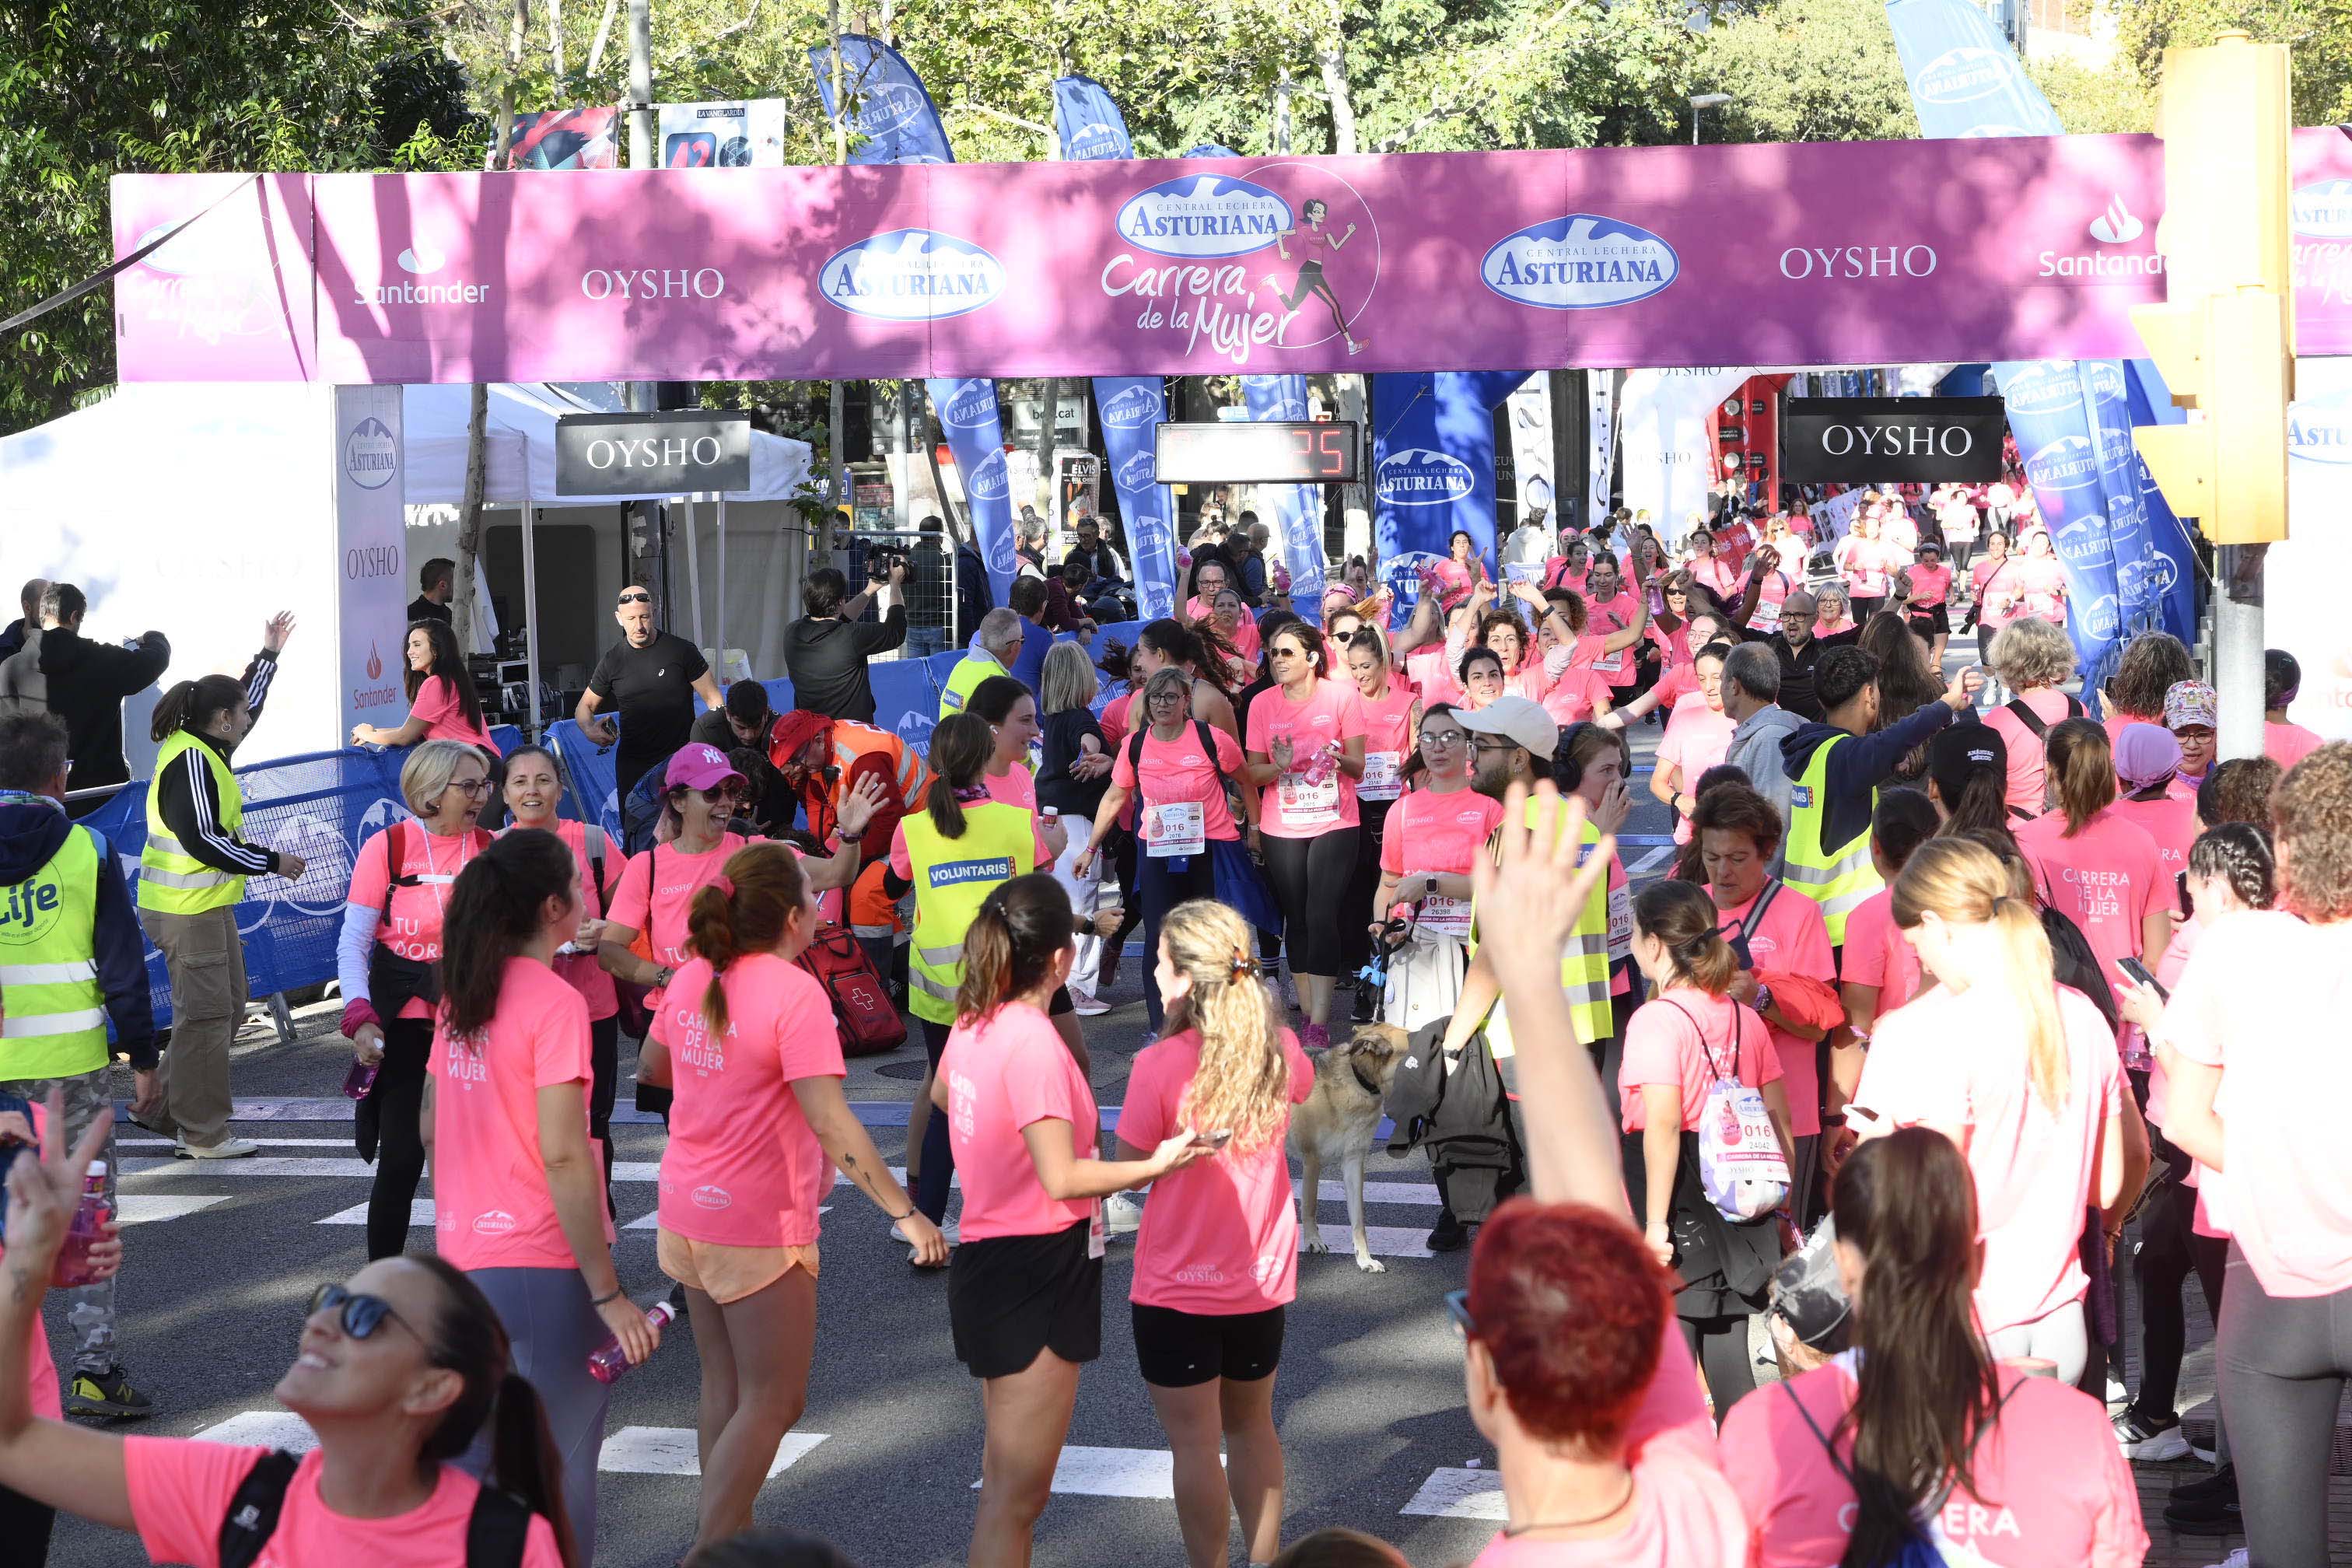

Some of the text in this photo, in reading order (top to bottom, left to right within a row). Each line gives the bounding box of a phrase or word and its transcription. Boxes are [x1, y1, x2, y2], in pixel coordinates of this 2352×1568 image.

[707, 109, 744, 117] VANGUARDIA
[1157, 201, 1274, 212] CENTRAL LECHERA
[2293, 205, 2352, 223] STUR
[1129, 205, 1279, 237] ASTURIANA
[1527, 246, 1657, 257] CENTRAL LECHERA
[1496, 251, 1663, 286] ASTURIANA
[1780, 245, 1937, 279] OYSHO
[2038, 250, 2168, 277] Santand
[581, 268, 724, 299] OYSHO
[1101, 254, 1248, 297] Carrera
[354, 280, 490, 304] Santander
[1137, 292, 1300, 364] de la Mujer
[1032, 408, 1075, 420] b.cat
[1822, 424, 1972, 457] OYSHO
[348, 443, 394, 471] ASTURIANA
[586, 436, 721, 469] OYSHO
[1072, 464, 1096, 474] ELVIS
[1379, 472, 1467, 493] ASTURIANA
[347, 545, 398, 580] OYSHO
[354, 685, 397, 710] Santander
[1366, 771, 1384, 779] 016
[1299, 792, 1319, 800] 016
[1165, 823, 1185, 832] 016
[930, 863, 1008, 883] VOLUNTARIS
[2063, 868, 2130, 887] CARRERA
[661, 883, 693, 894] OYSHO
[2077, 885, 2116, 900] DE LA
[1430, 897, 1454, 907] 016
[2077, 901, 2120, 916] MUJER
[395, 917, 419, 936] TU
[1612, 912, 1629, 927] 016
[677, 1009, 738, 1039] CARA
[685, 1029, 722, 1053] DE LA
[681, 1046, 724, 1071] MUJER
[1745, 1125, 1771, 1137] 016
[1749, 1141, 1770, 1150] 24042
[1176, 1270, 1224, 1283] OYSHO
[1837, 1502, 2021, 1538] CERA
